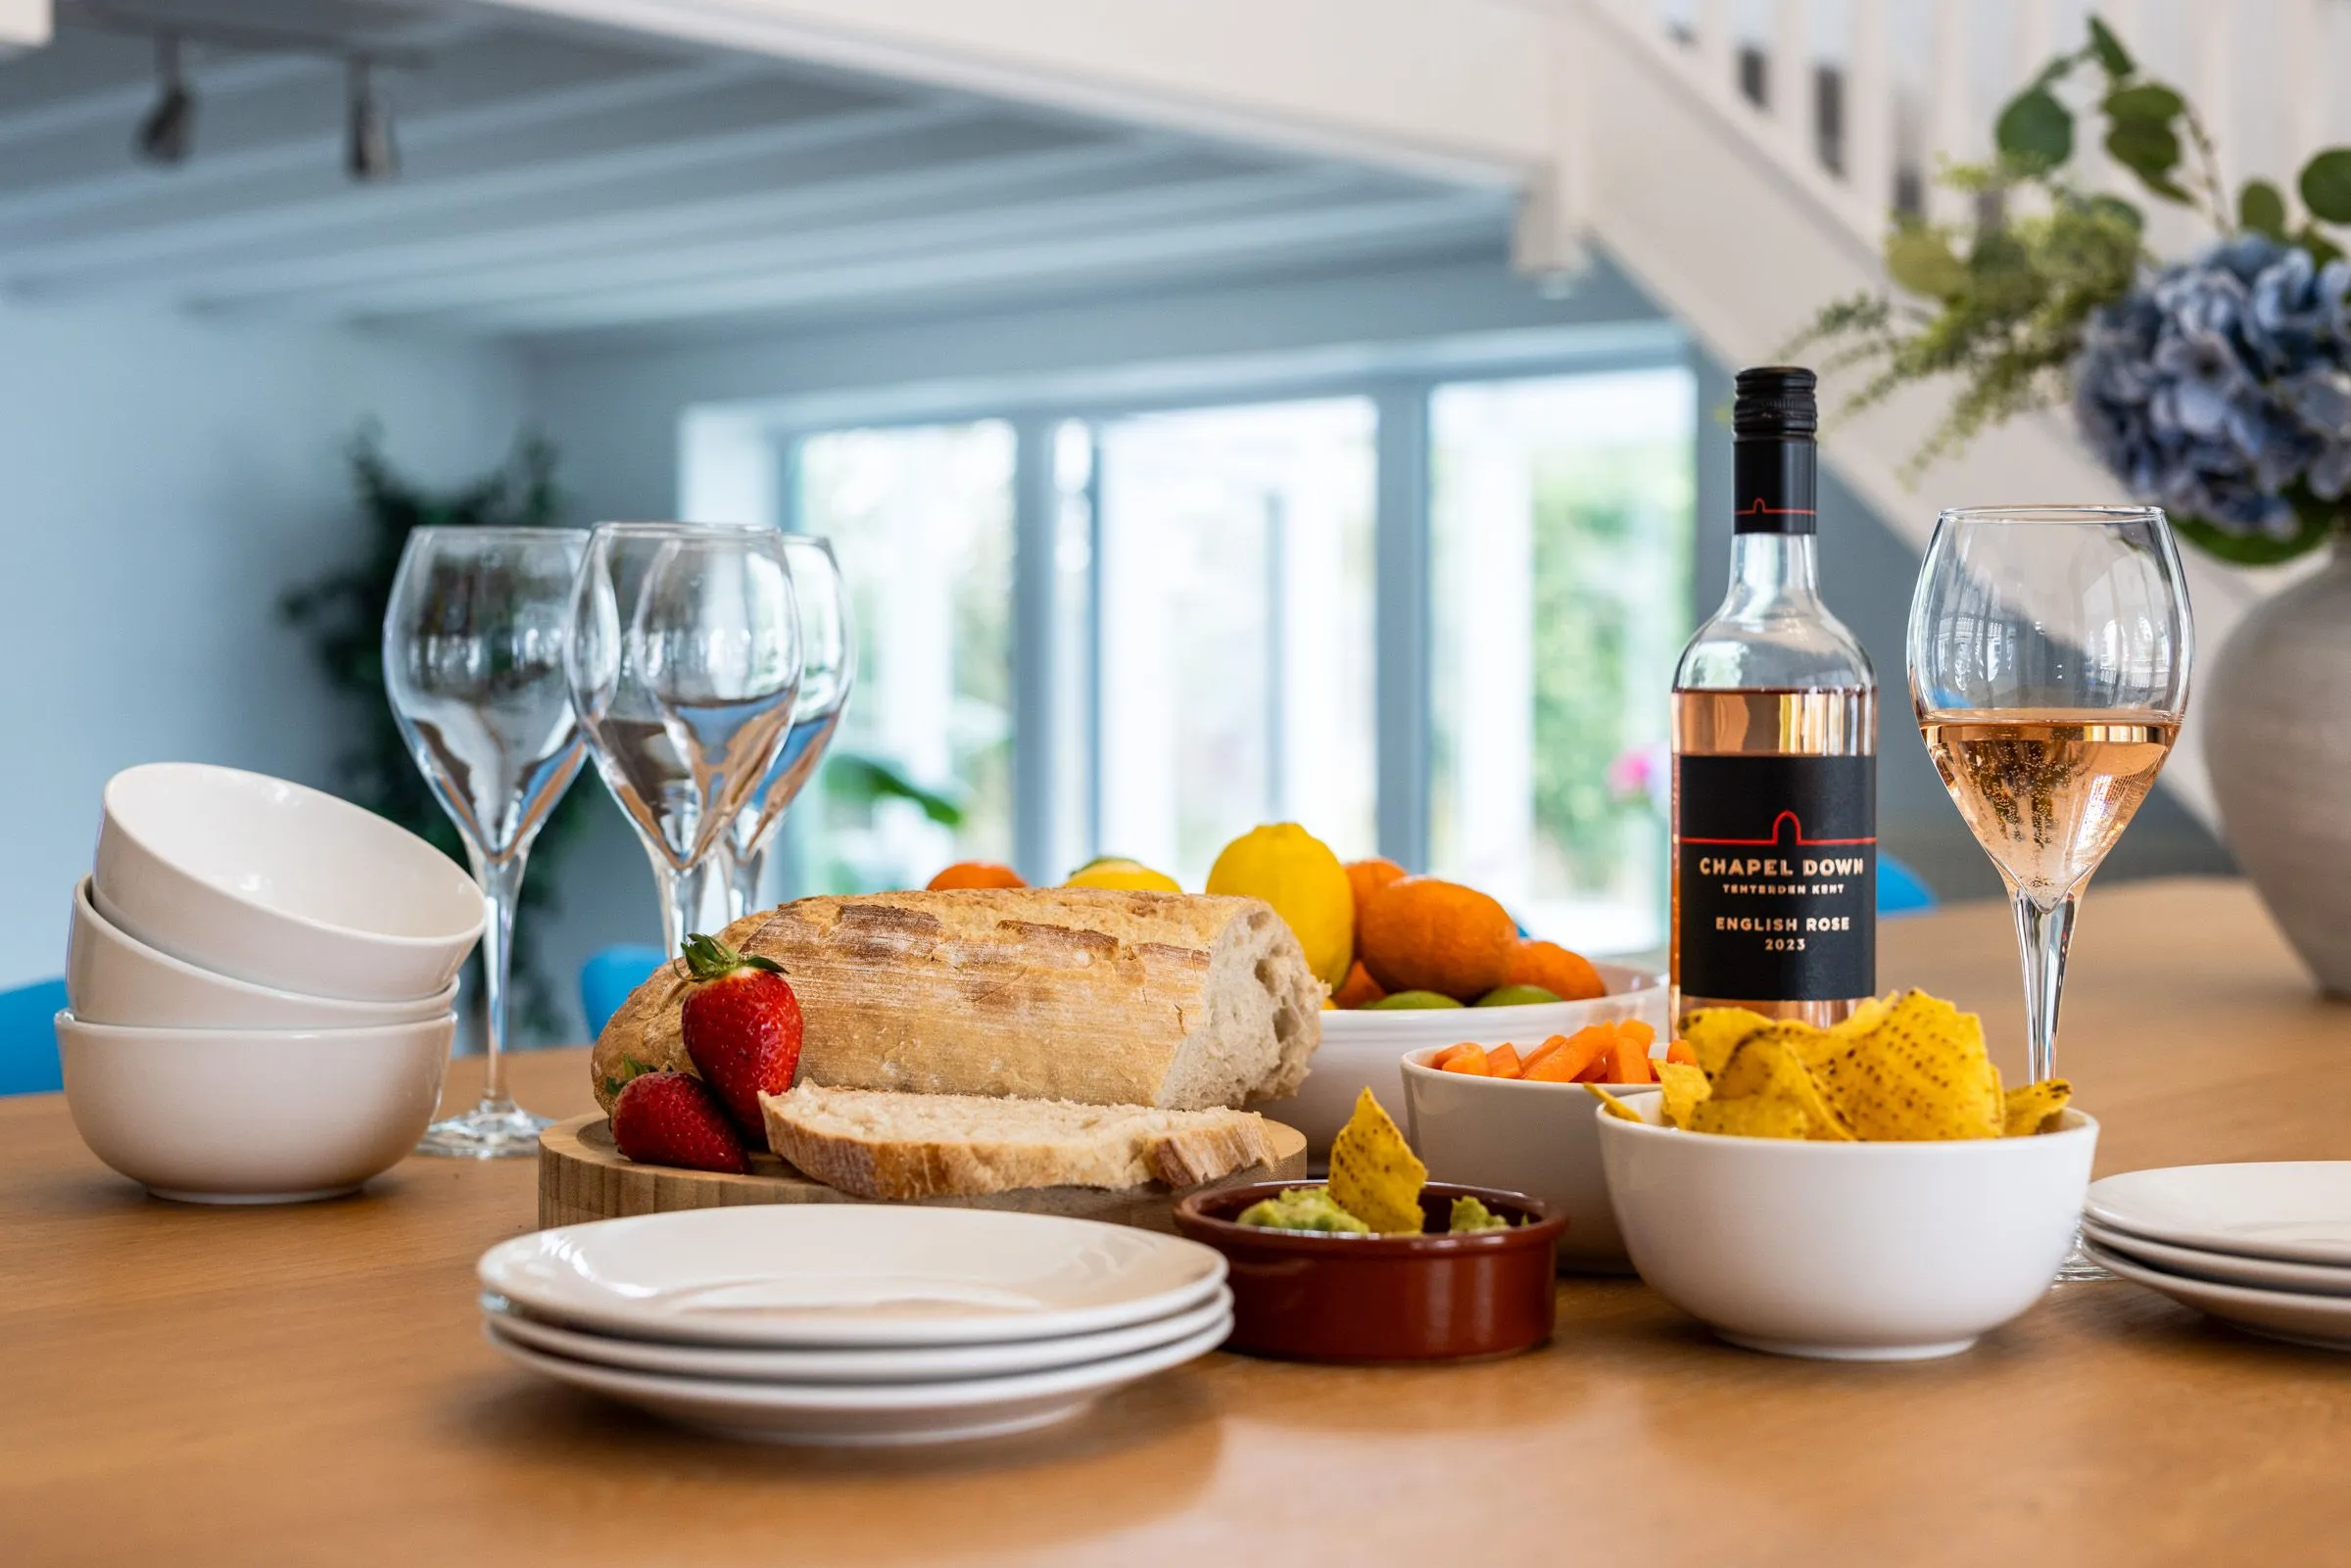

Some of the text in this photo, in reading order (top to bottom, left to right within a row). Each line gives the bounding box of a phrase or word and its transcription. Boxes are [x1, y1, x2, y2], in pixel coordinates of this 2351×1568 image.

[1699, 857, 1864, 877] CHAPEL DOWN
[1722, 883, 1845, 895] TENTERDEN KENT
[1715, 917, 1850, 931] ENGLISH ROSE
[1764, 938, 1806, 951] 2023
